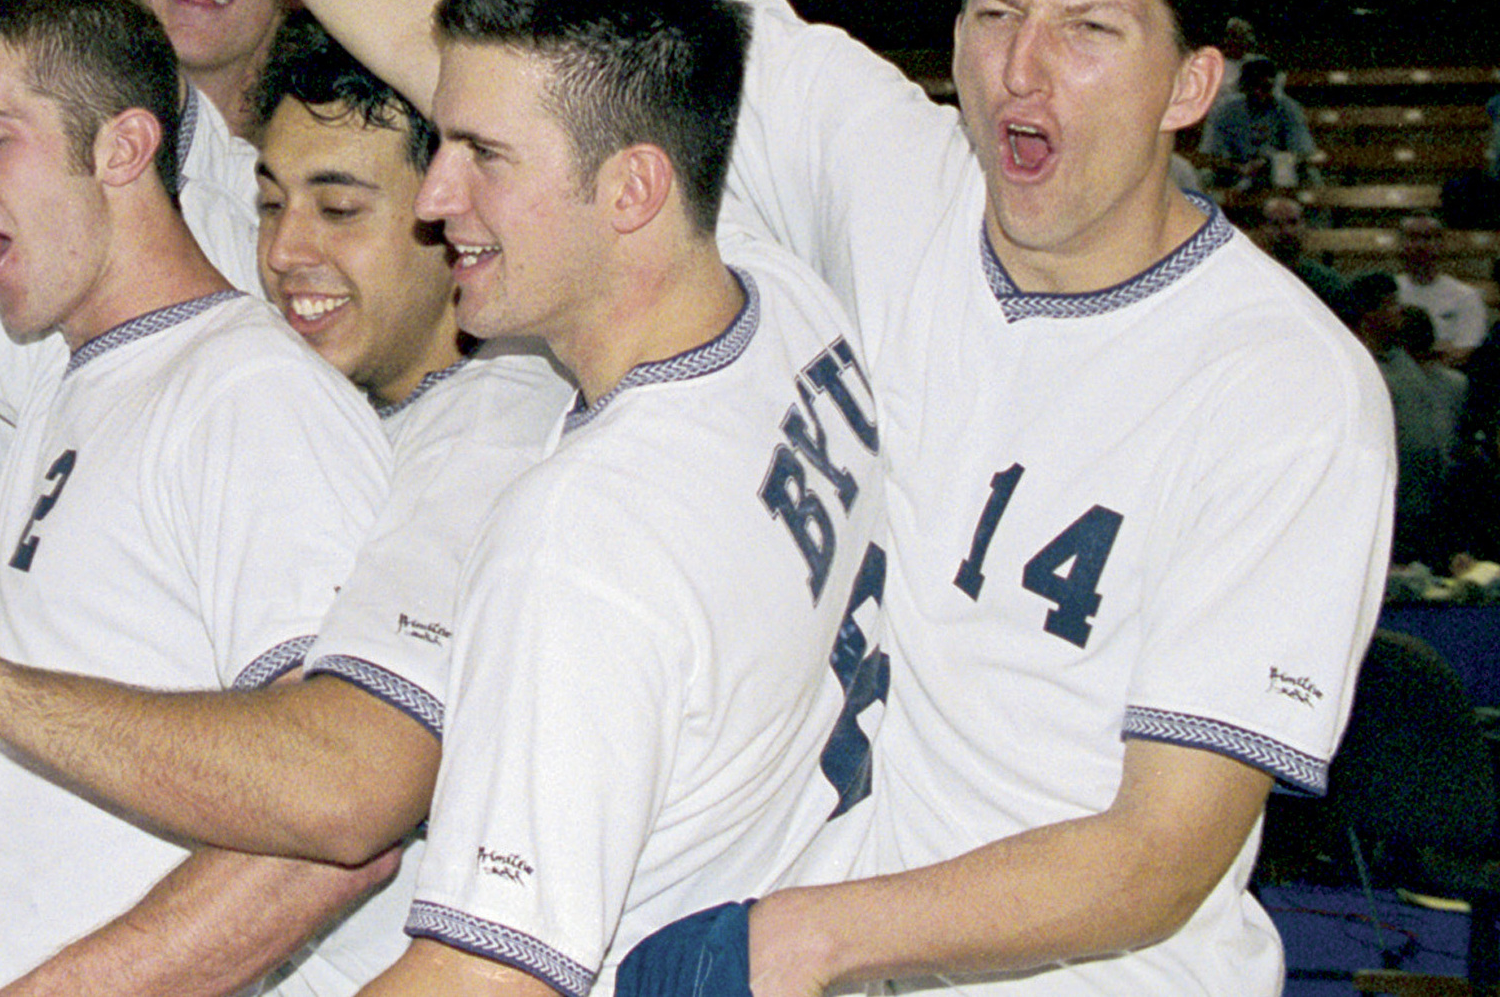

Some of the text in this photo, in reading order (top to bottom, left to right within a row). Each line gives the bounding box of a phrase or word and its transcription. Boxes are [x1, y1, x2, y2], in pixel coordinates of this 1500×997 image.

[8, 449, 77, 573] 2
[757, 335, 880, 609] BYU
[952, 462, 1125, 650] 14
